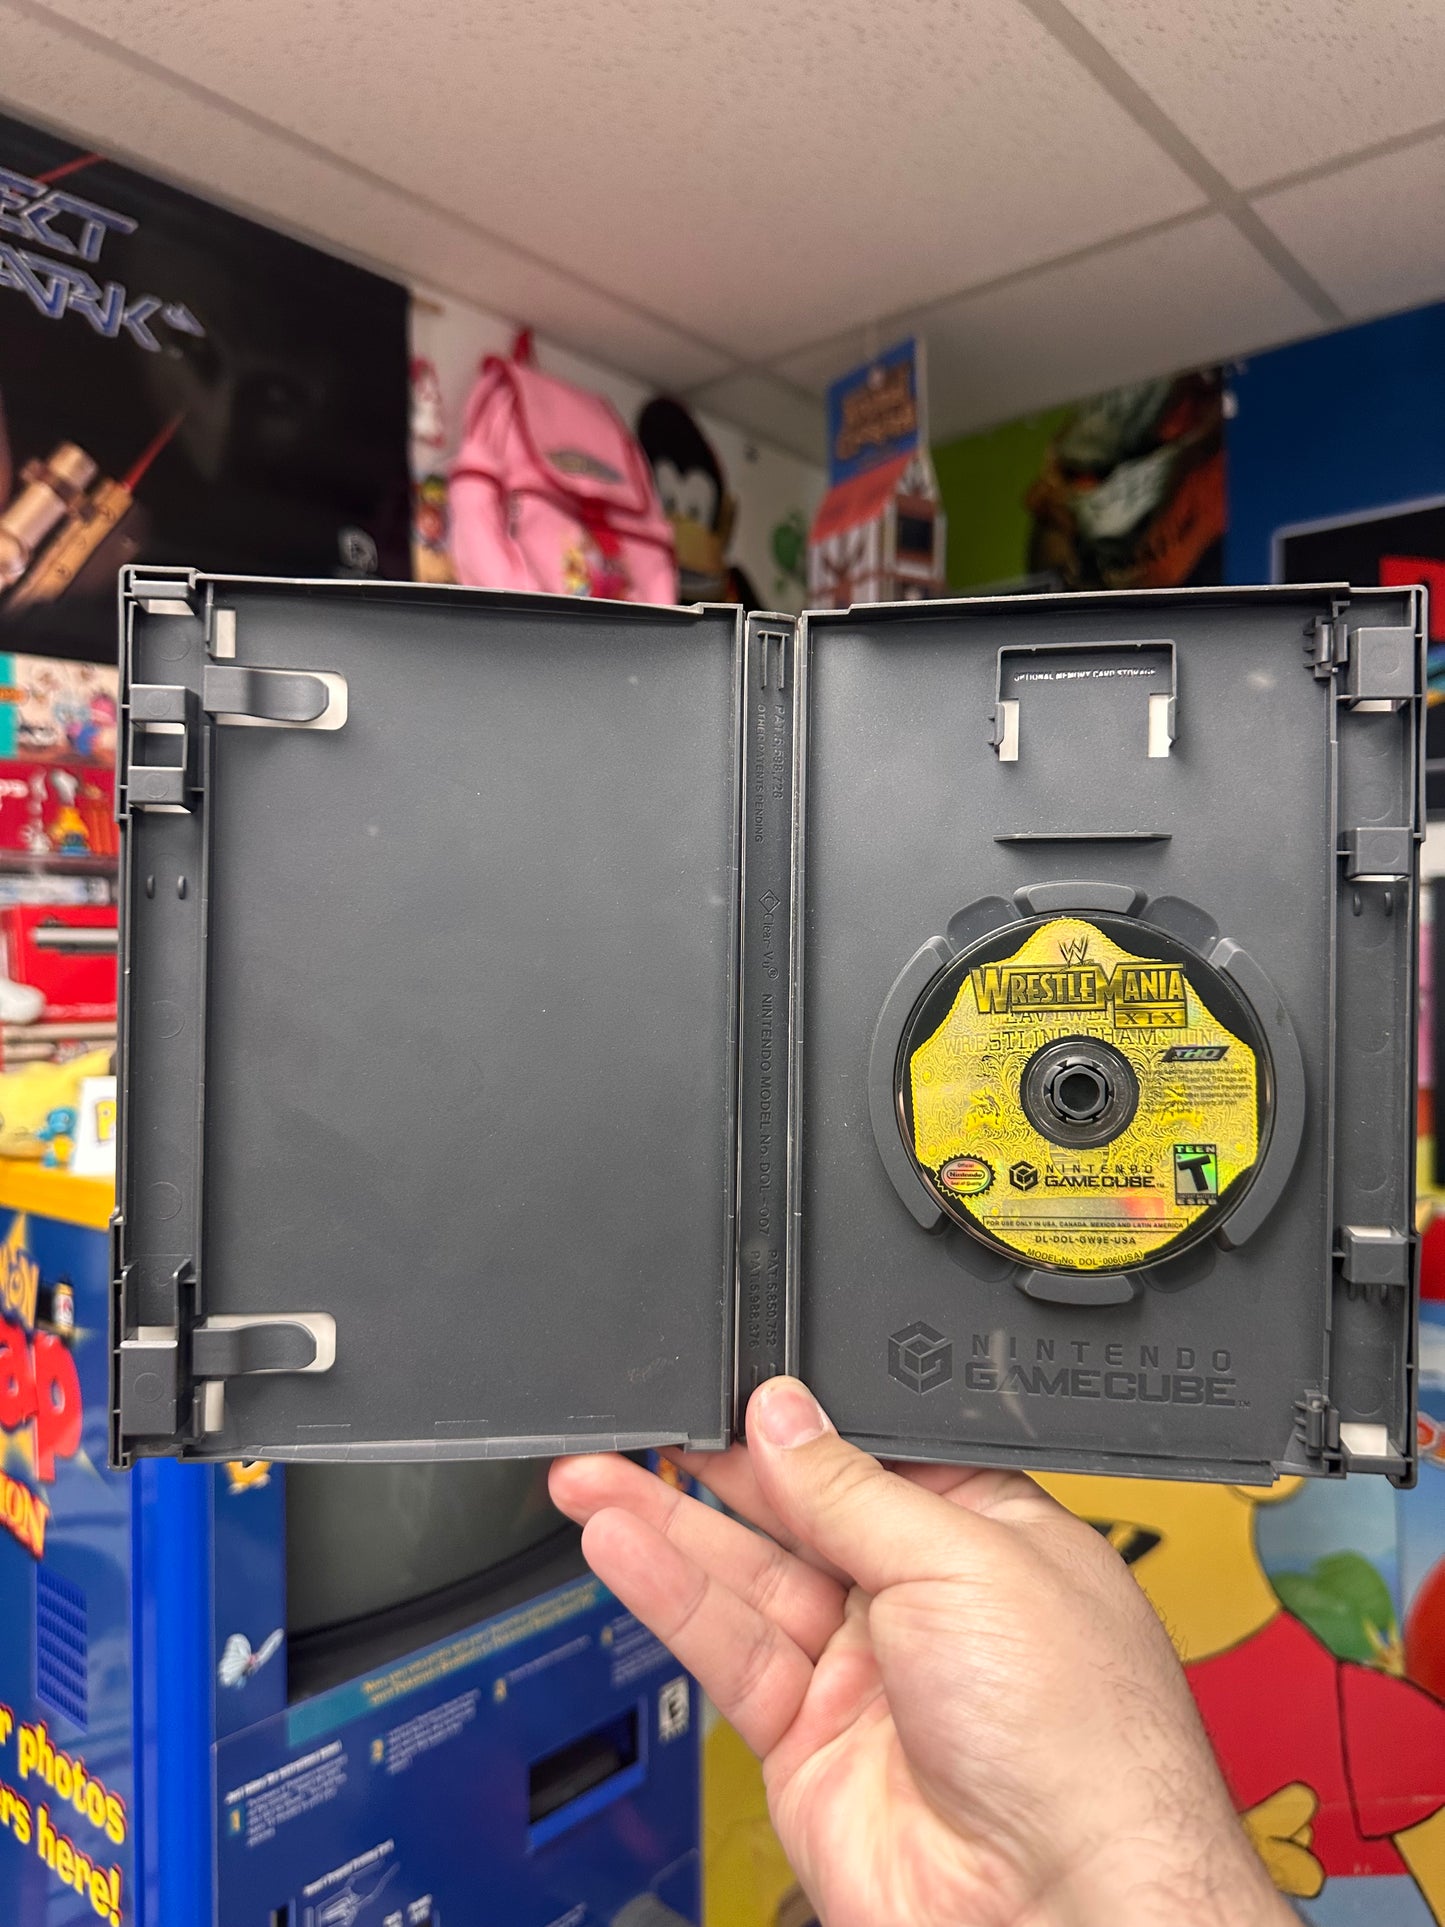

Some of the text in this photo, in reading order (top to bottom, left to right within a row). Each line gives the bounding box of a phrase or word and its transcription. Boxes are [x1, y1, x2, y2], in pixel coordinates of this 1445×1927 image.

[754, 703, 767, 844] OTHER PATENTS PENDING
[760, 993, 773, 1072] NINTENDO
[1123, 1012, 1177, 1025] XIX
[1170, 1047, 1224, 1061] THQ
[760, 1076, 771, 1130] MODEL
[760, 1133, 771, 1158] No.
[1175, 1145, 1215, 1153] TEEN
[1046, 1164, 1153, 1174] NINTENDO
[1177, 1155, 1211, 1192] T
[1026, 1247, 1059, 1263] MODEL
[1035, 1235, 1136, 1245] DL-DOL-GW9E-USA
[971, 1333, 1232, 1372] NINTENDO
[18, 1719, 127, 1845] photos
[37, 1801, 123, 1927] here!
